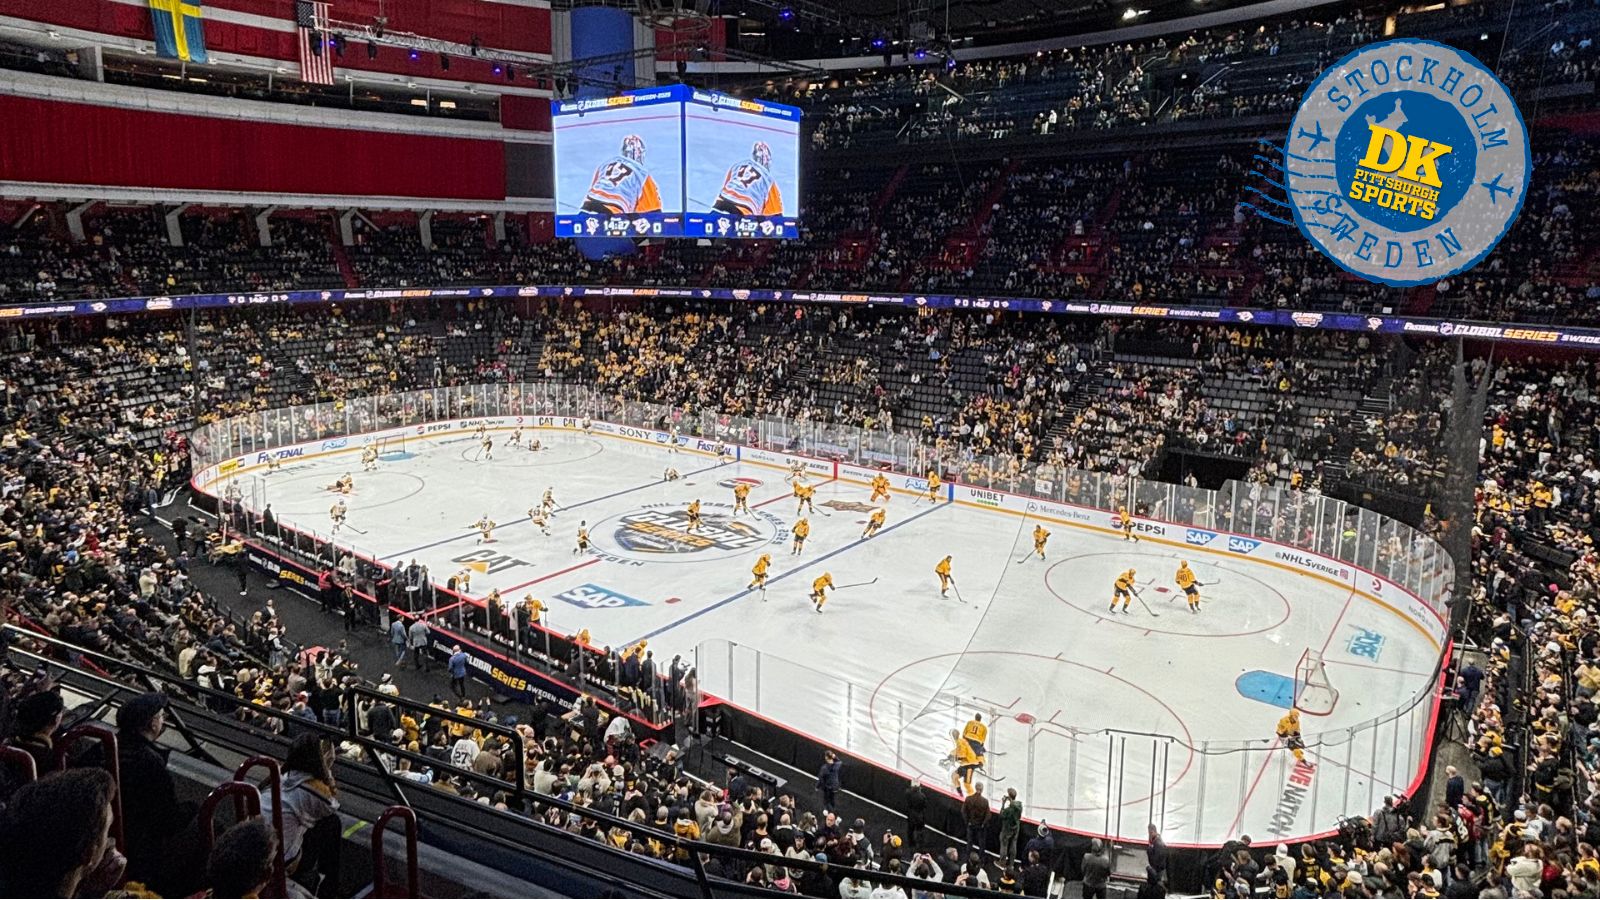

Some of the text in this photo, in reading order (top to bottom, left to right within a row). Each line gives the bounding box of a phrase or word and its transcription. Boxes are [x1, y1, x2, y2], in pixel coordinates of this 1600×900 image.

[604, 220, 630, 230] 14:27
[735, 221, 758, 232] 14:27
[1098, 304, 1133, 314] GLOBAL
[1132, 307, 1169, 316] SERIES
[1453, 324, 1503, 338] GLOBAL
[1503, 329, 1560, 342] SERIES
[428, 424, 452, 433] PEPSI
[538, 416, 554, 427] CAT
[563, 417, 577, 428] CAT
[620, 427, 653, 440] SONY
[697, 440, 732, 456] FASTAL
[257, 448, 305, 465] FATENAL
[970, 488, 1005, 503] UNIBET
[1131, 520, 1166, 536] PEPSI
[1187, 533, 1211, 546] SAP
[1229, 541, 1255, 553] SAP
[451, 549, 531, 575] CAT
[561, 586, 626, 608] SAP
[491, 667, 527, 691] SERIES
[454, 750, 469, 765] 27
[1267, 784, 1309, 836] NATION
